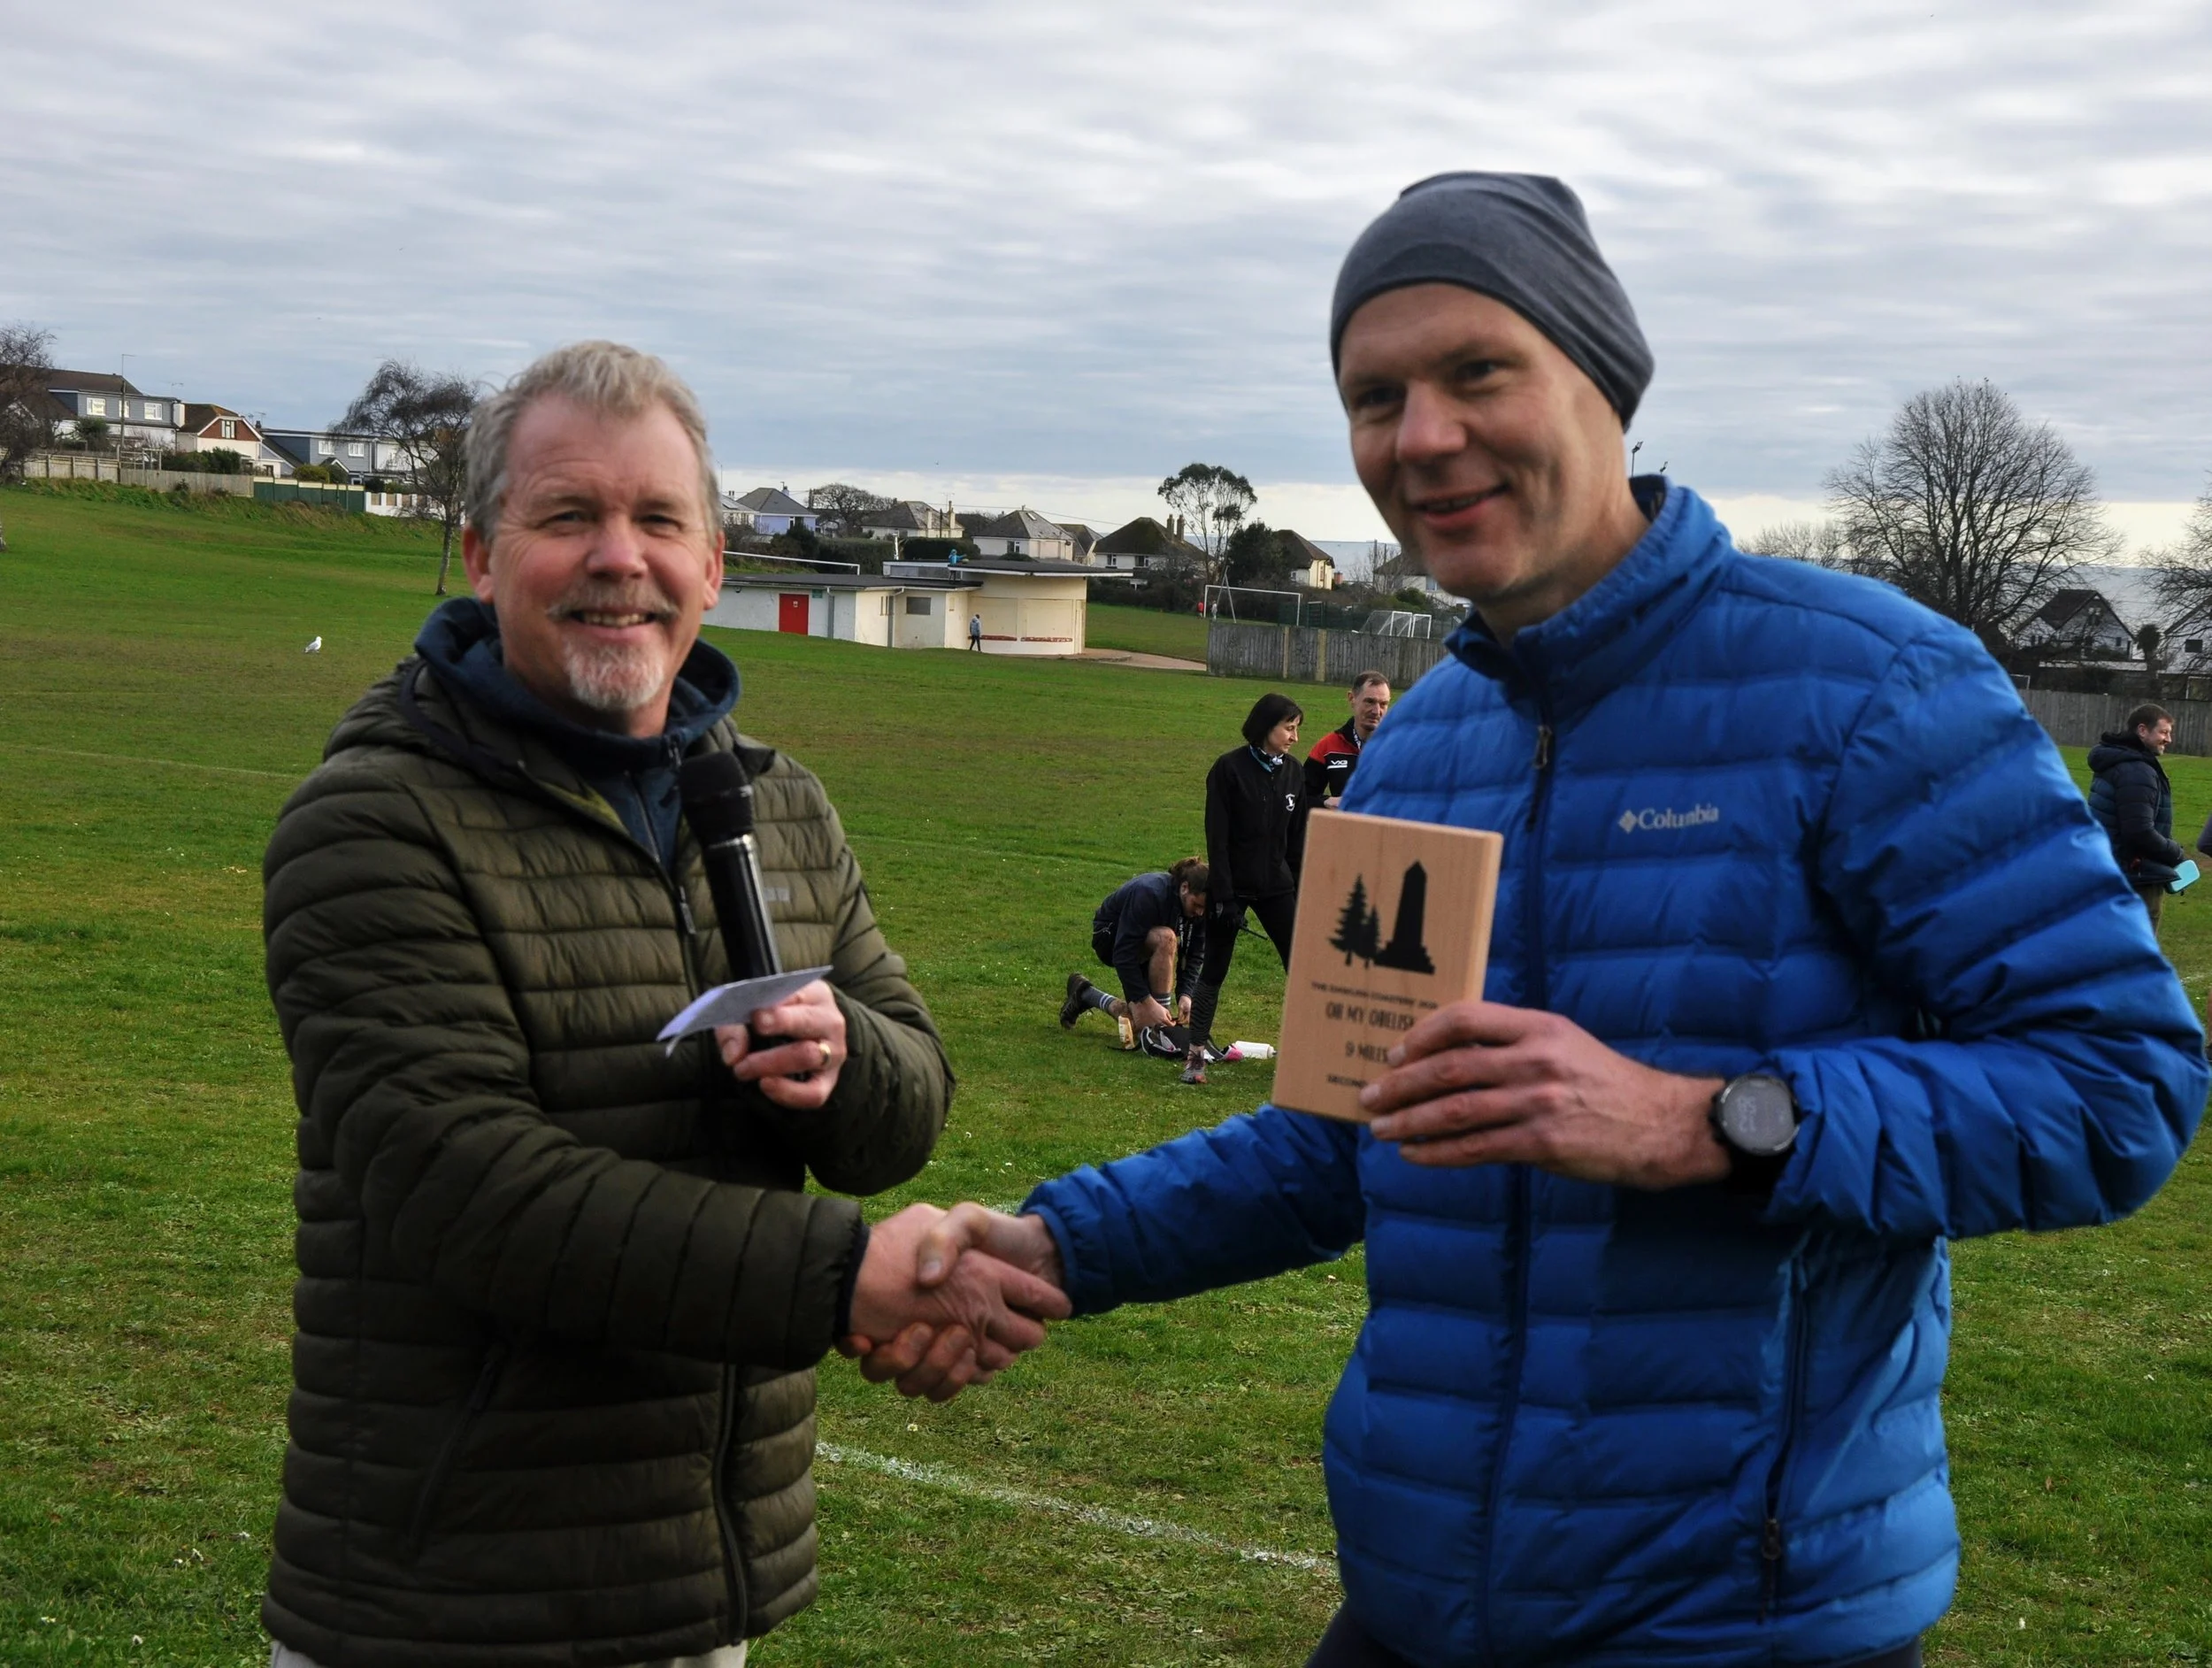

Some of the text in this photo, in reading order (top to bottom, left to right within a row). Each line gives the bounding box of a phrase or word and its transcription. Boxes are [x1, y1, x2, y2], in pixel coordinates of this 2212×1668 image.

[1639, 803, 1719, 830] Columbia
[1348, 1005, 1364, 1024] MY
[1345, 1040, 1355, 1057] 9
